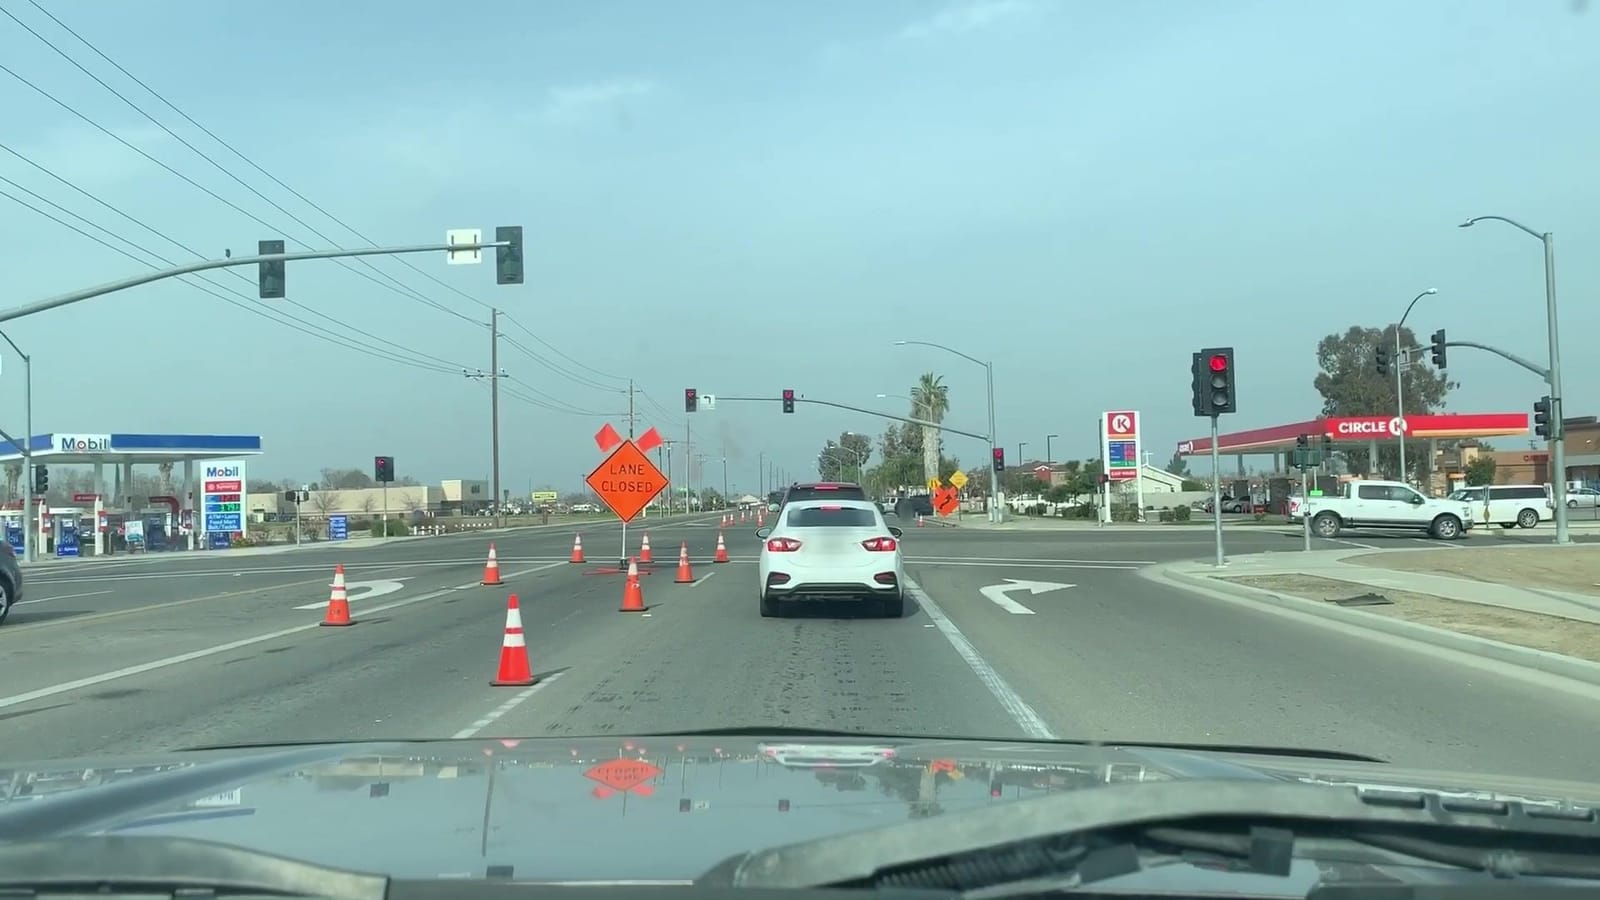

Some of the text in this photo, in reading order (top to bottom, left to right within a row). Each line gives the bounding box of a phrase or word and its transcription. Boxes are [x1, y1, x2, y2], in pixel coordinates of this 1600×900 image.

[1339, 421, 1386, 434] CIRCLE
[62, 437, 107, 450] Mobil
[207, 466, 239, 477] Mobil
[610, 463, 645, 476] LANE
[601, 480, 654, 493] CLOSED
